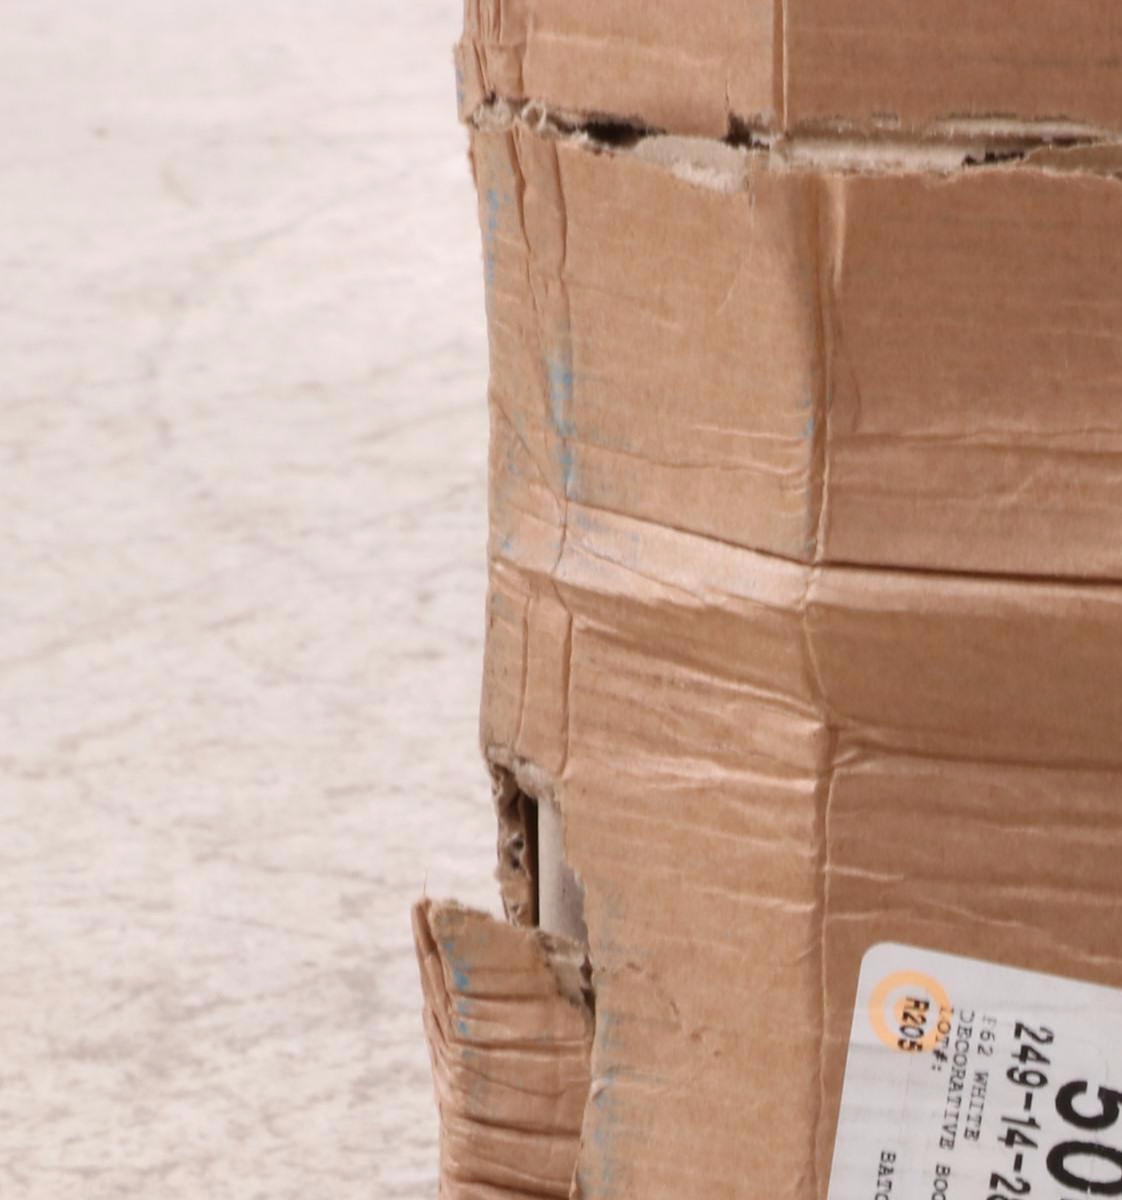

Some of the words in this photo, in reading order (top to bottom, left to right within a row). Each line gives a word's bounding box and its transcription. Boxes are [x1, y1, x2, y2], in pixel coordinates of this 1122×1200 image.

[897, 996, 931, 1054] R205
[938, 1009, 975, 1151] DECORATIVE
[963, 1071, 990, 1143] WHITE
